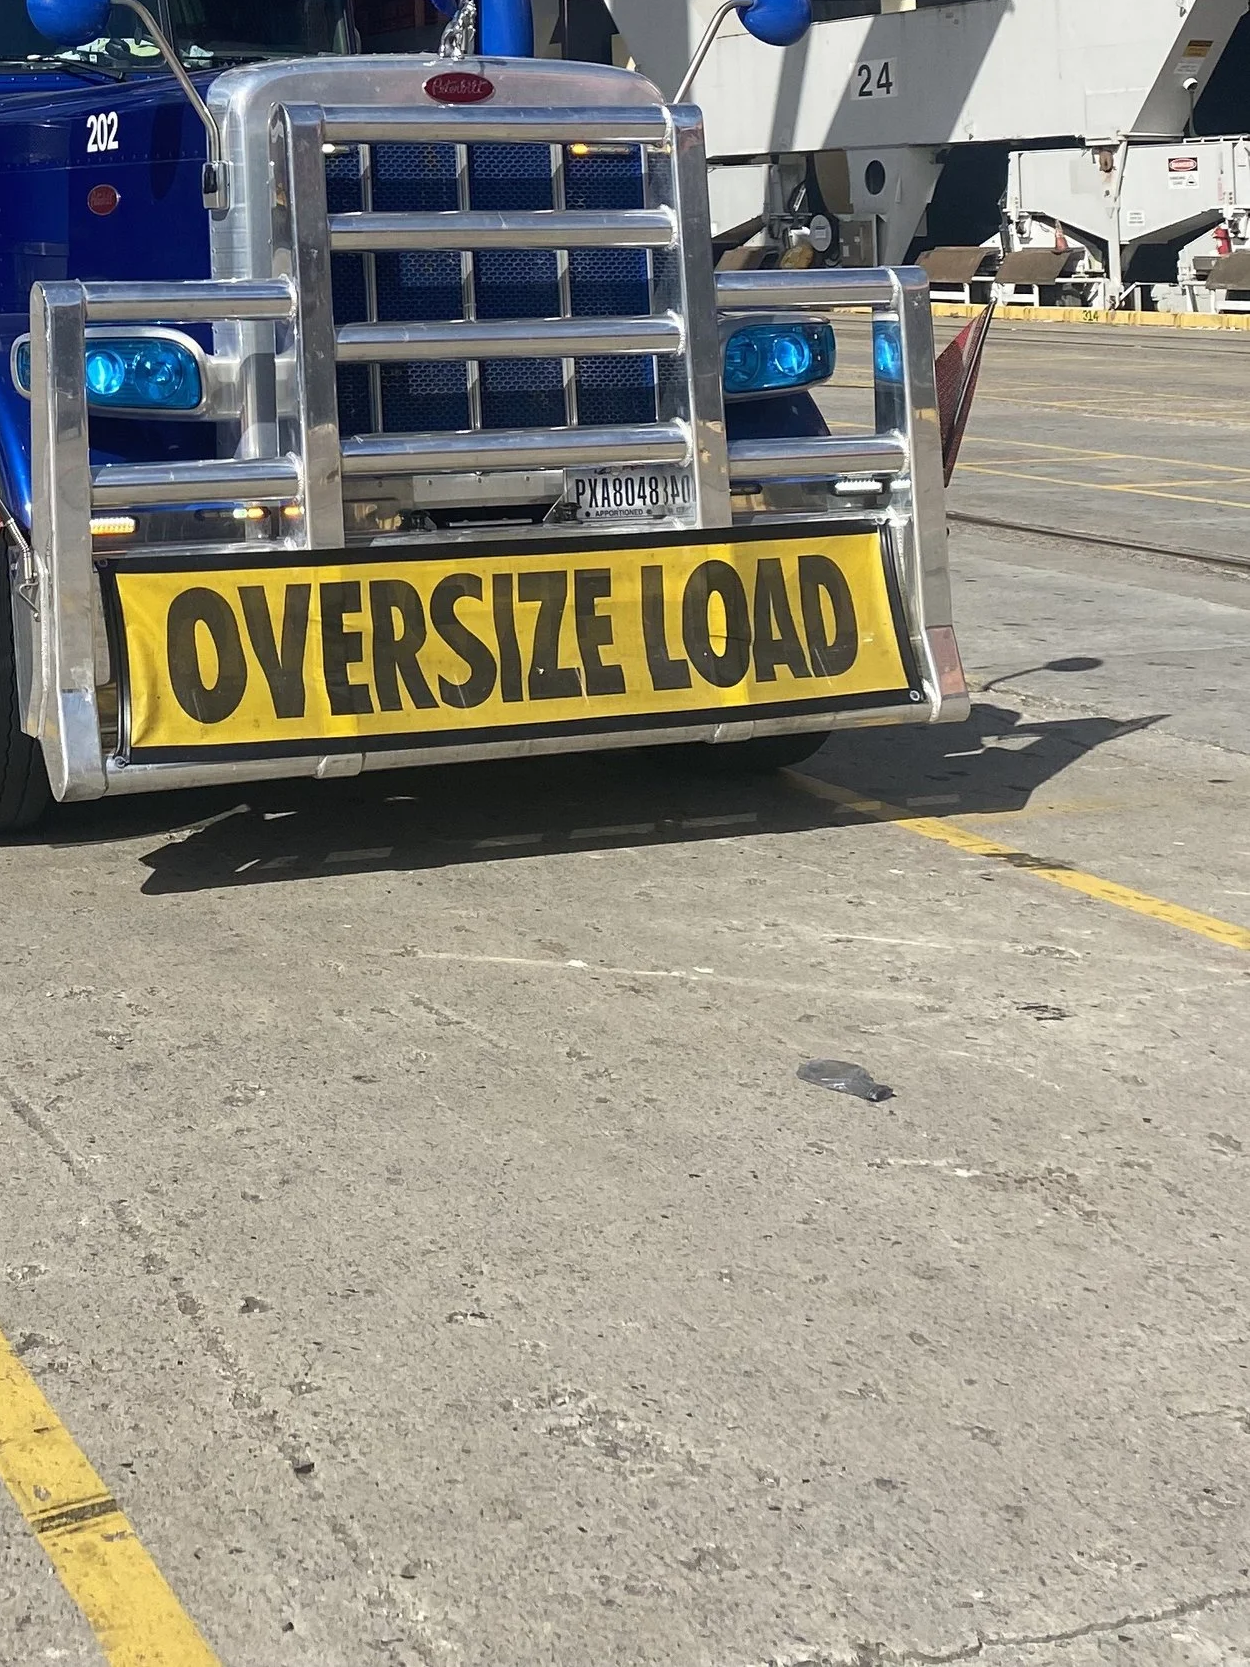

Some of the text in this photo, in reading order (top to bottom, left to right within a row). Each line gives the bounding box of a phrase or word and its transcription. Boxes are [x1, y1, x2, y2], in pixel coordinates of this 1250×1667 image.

[857, 61, 893, 97] 24
[87, 111, 119, 153] 202
[575, 476, 659, 508] PXA8048
[595, 508, 644, 517] APPORTIONED
[166, 554, 859, 725] OVERSIZE LOAD
